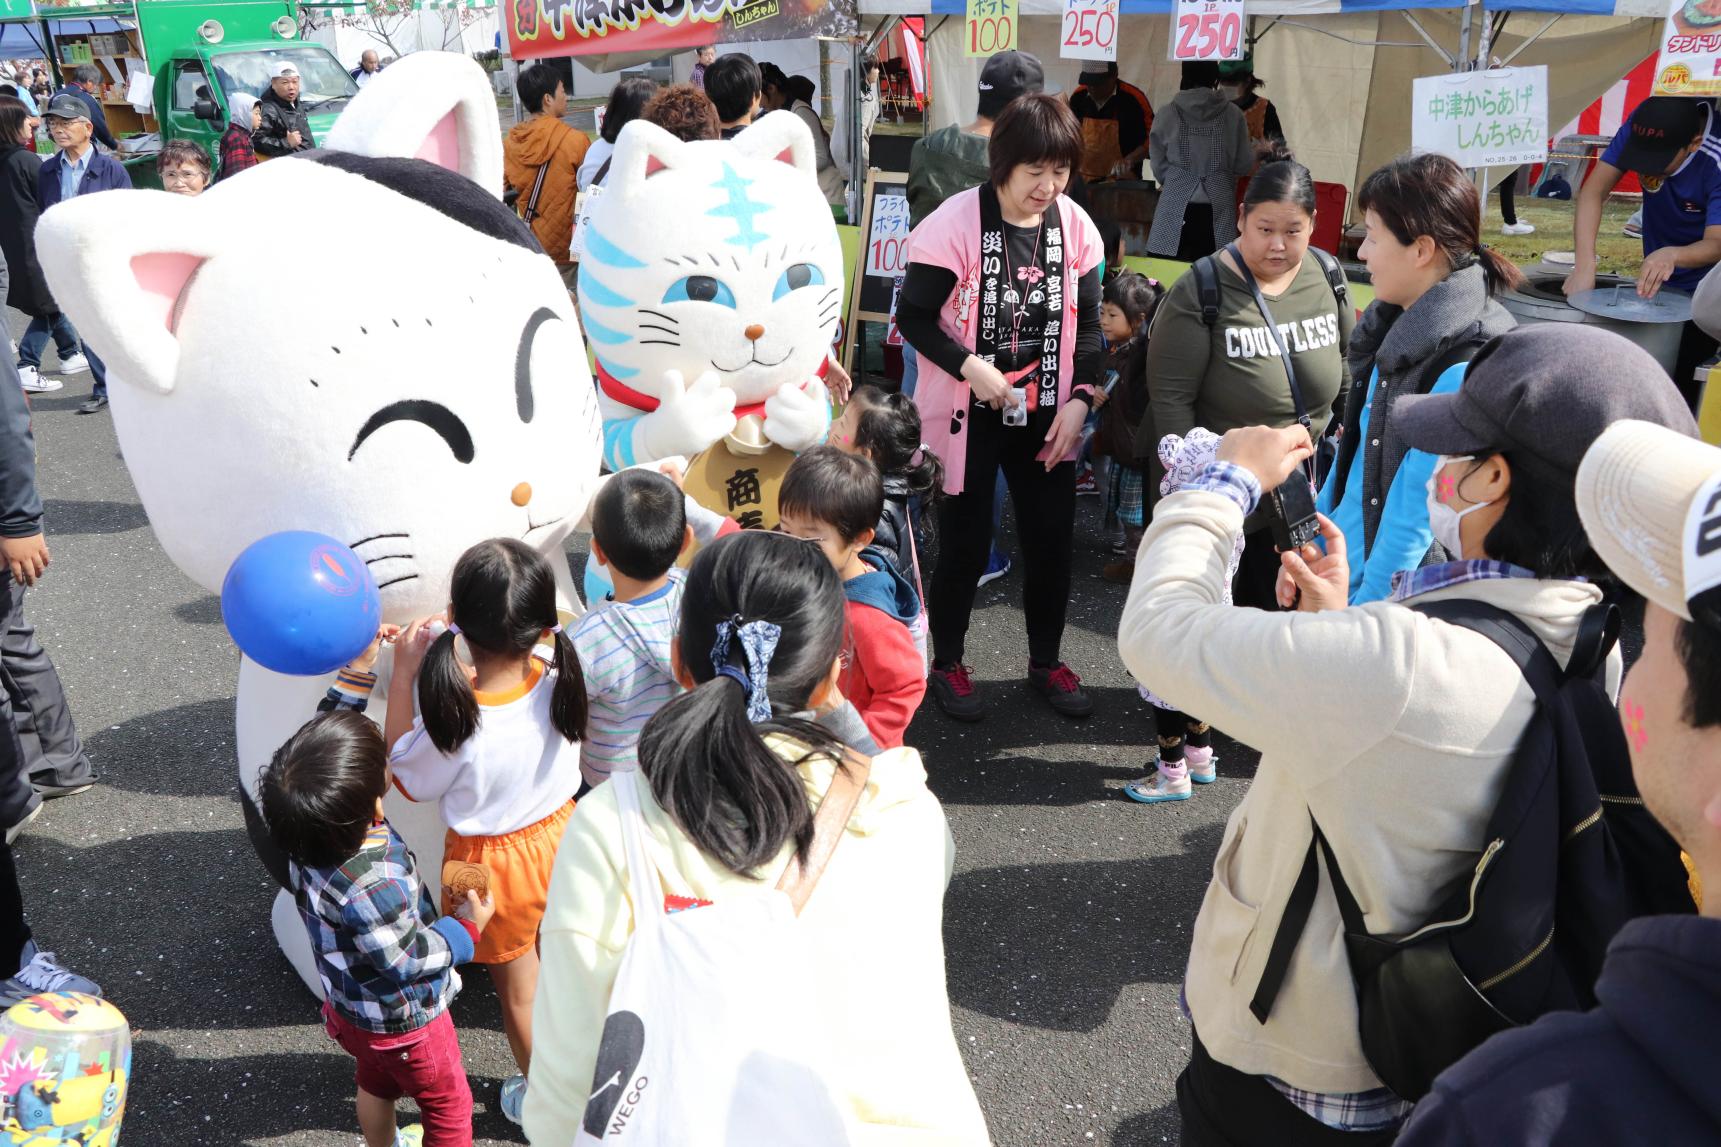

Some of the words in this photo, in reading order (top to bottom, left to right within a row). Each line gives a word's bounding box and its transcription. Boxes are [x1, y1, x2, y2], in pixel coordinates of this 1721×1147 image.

[968, 16, 1011, 53] 100
[1064, 10, 1115, 47] 250
[1176, 12, 1241, 58] 250
[1429, 84, 1533, 122] 中津からあげ
[1458, 117, 1540, 149] しんちゃん
[609, 1075, 649, 1136] WEGO
